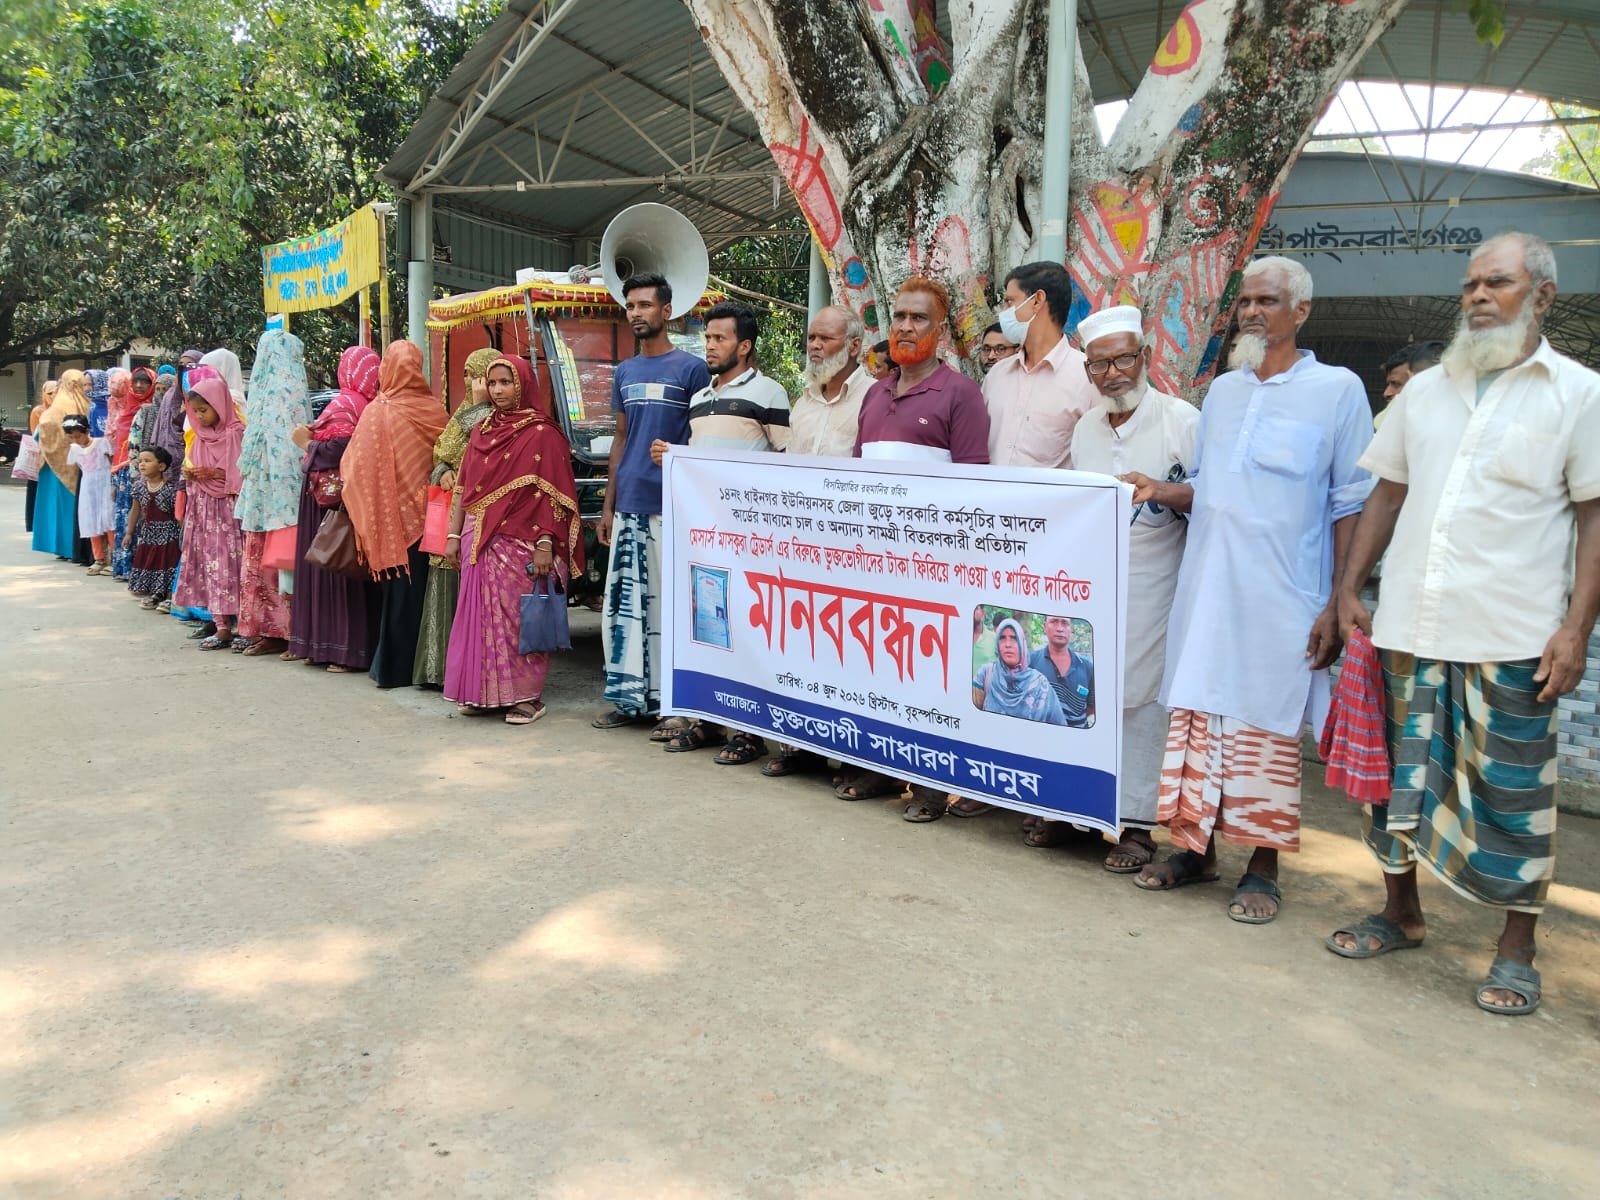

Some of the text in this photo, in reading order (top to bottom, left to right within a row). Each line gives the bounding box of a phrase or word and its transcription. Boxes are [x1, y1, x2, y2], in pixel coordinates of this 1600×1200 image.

[719, 486, 1047, 534] ১৪নং ধাইনগর ইউনিয়নসহ জেলা জুড়ে সরকারি কর্মসূচির আদলে
[731, 506, 1028, 557] কার্ডের মাধ্যমে চাল ও অন্যান্য সামগ্রী বিতরণকারী প্রতিষ্ঠান
[689, 524, 717, 549] মেসার্স
[750, 531, 774, 557] ট্রেডার্স
[776, 540, 789, 560] এর
[792, 535, 821, 566] বিরুদ্ধে
[824, 543, 884, 574] ভুক্তভোগীদের
[886, 549, 909, 578] টাকা
[912, 551, 950, 584] ফিরিয়ে
[954, 561, 988, 590] পাওয়া
[992, 570, 1001, 590] ও
[1005, 564, 1041, 598] শাস্তির
[1044, 569, 1091, 603] দাবিতে
[744, 565, 960, 694] মানববন্ধন
[775, 671, 803, 690] তারিখ:
[806, 682, 820, 694] ০৪
[823, 683, 837, 700] জুন
[840, 689, 865, 706] ২০২৬
[904, 704, 961, 730] বৃহস্পতিবার
[713, 690, 1043, 799] আয়োজনে: ভুক্তভোগী সাধারণ মানুষ
